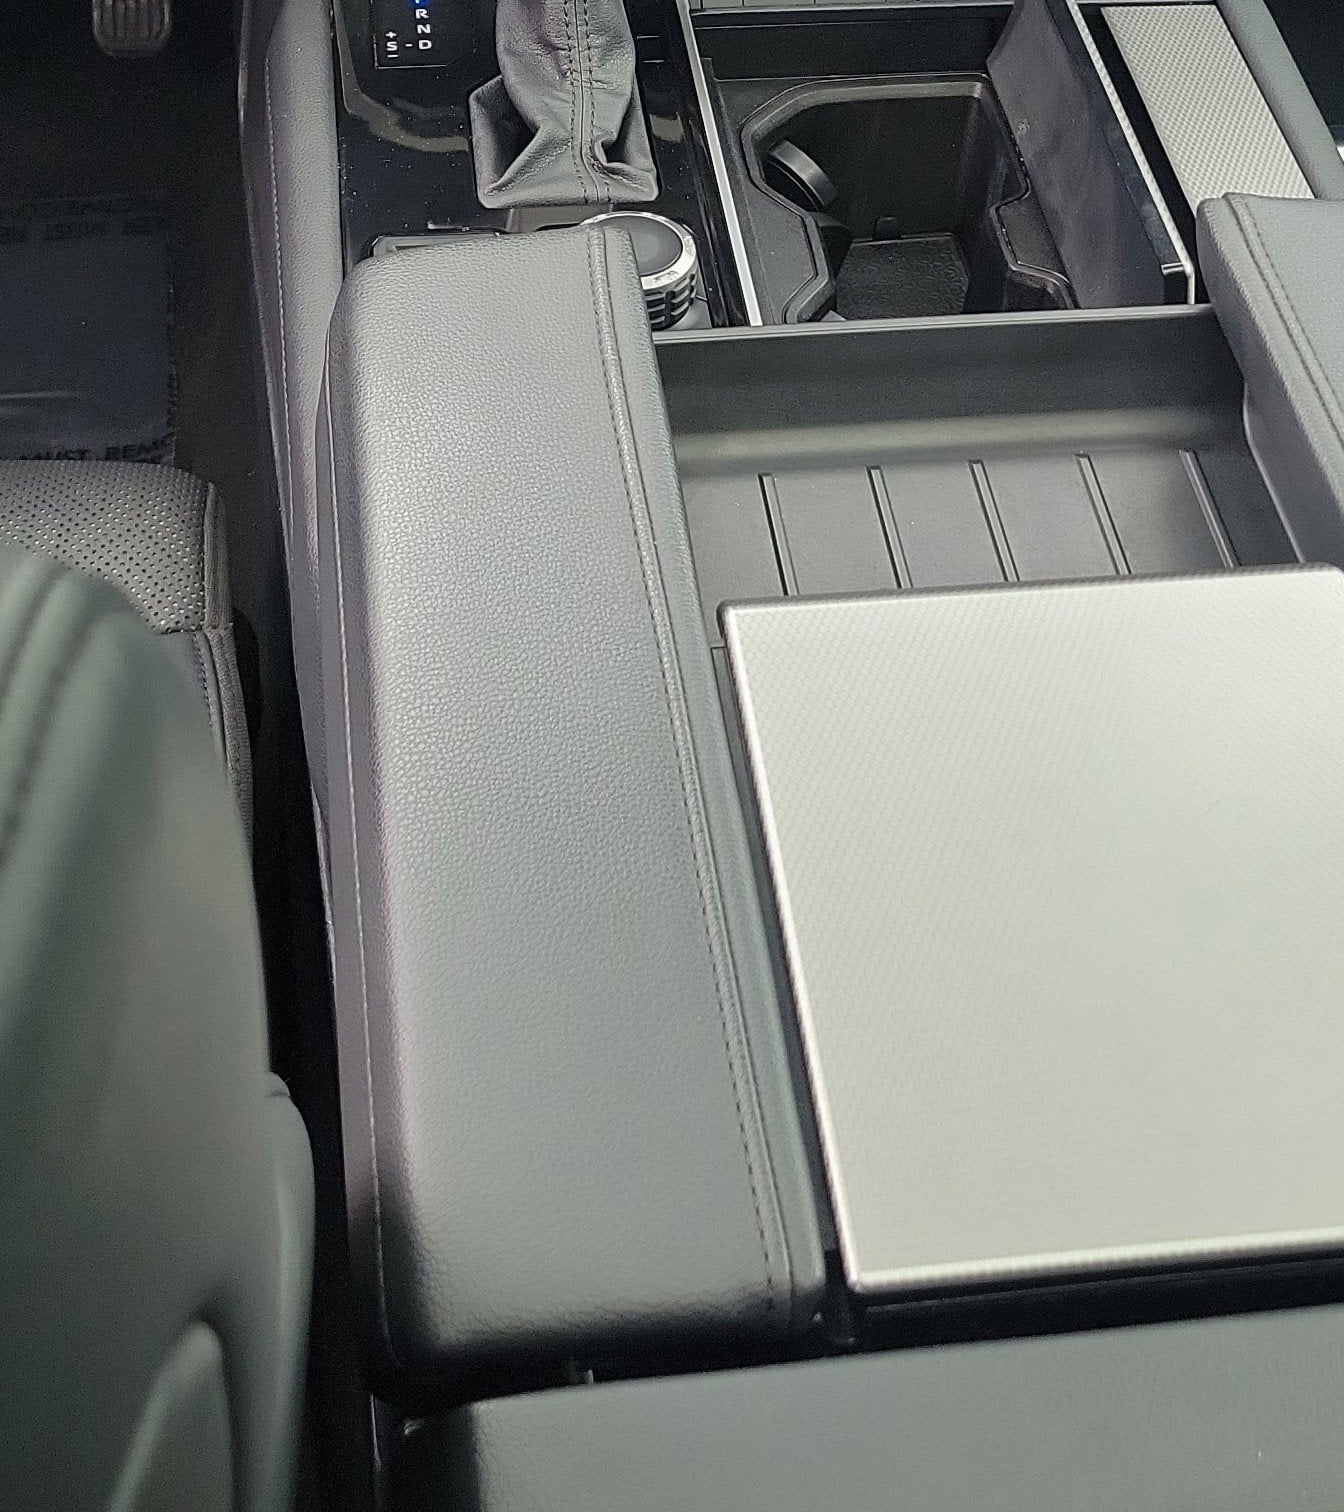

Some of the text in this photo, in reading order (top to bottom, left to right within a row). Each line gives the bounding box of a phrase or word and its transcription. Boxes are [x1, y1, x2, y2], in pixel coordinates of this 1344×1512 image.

[415, 8, 429, 19] R
[417, 24, 431, 34] N
[386, 39, 432, 51] S D
